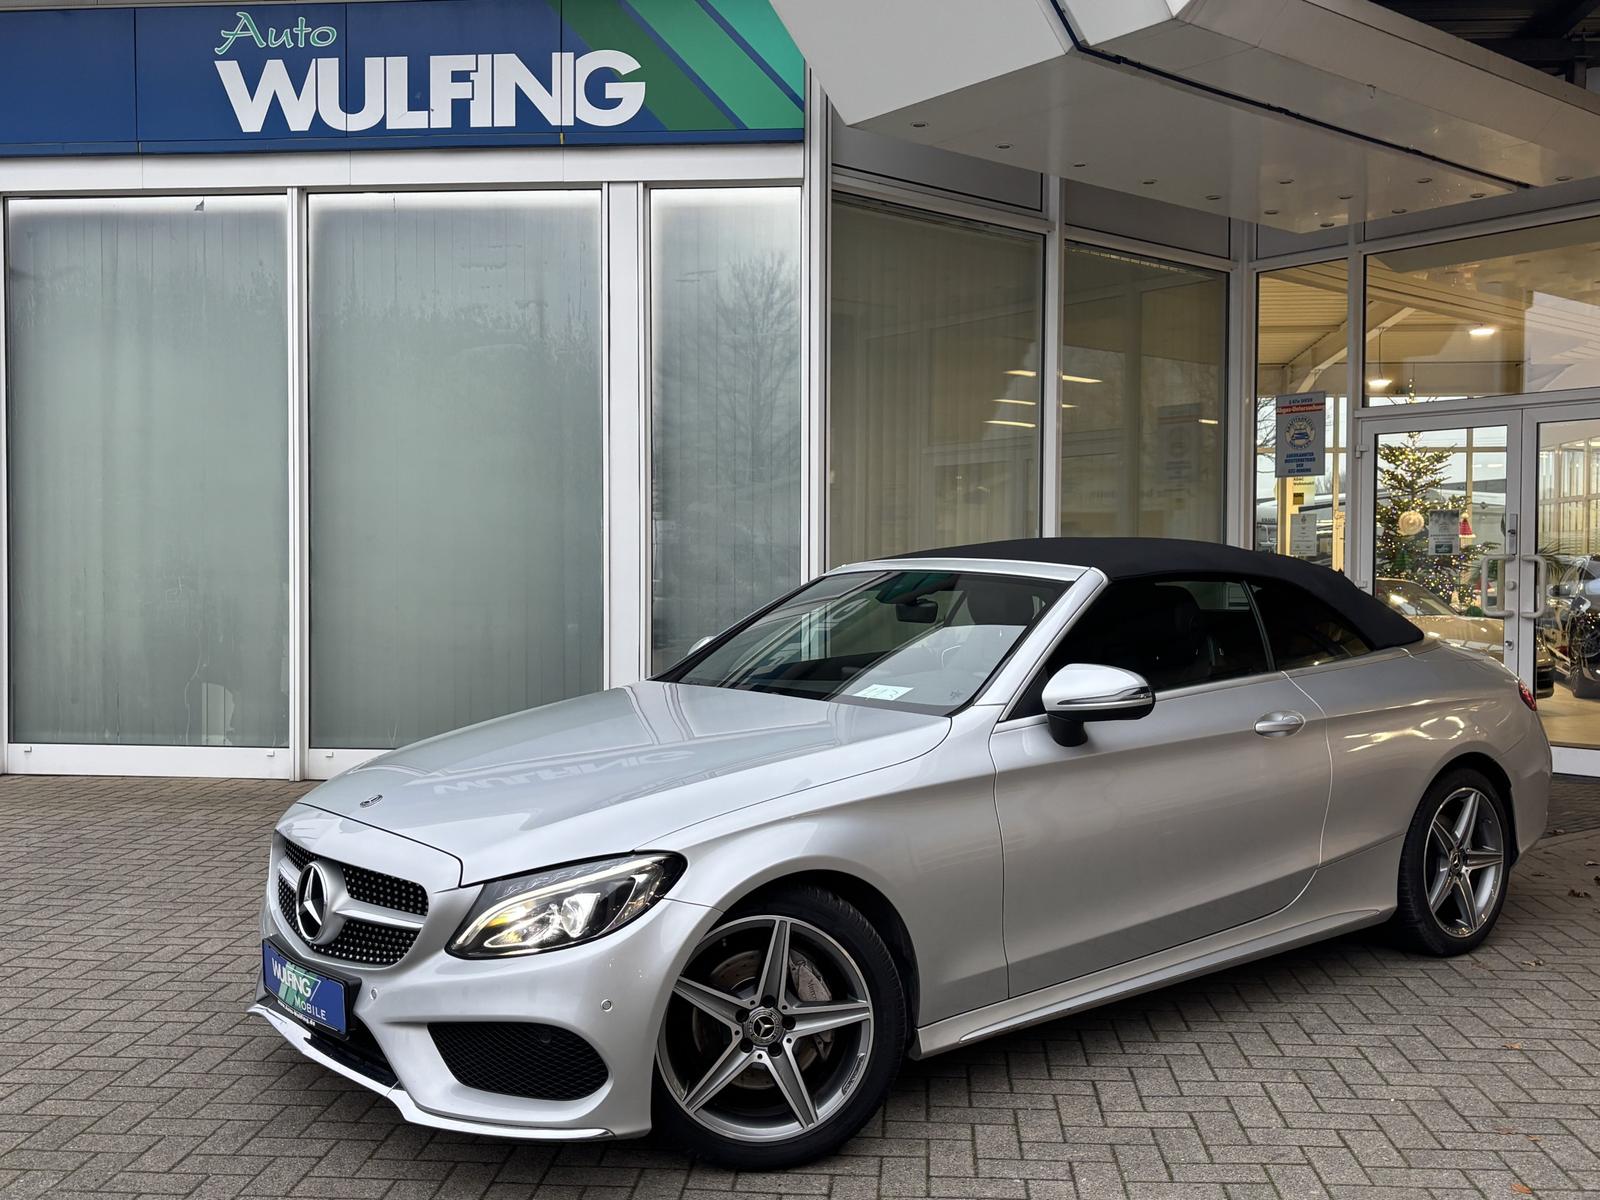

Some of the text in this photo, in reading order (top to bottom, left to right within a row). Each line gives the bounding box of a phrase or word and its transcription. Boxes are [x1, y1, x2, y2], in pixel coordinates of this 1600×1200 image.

[214, 11, 338, 55] Auto
[214, 49, 646, 133] WULFING
[271, 957, 312, 998] WULFING
[294, 994, 327, 1021] MOBILE
